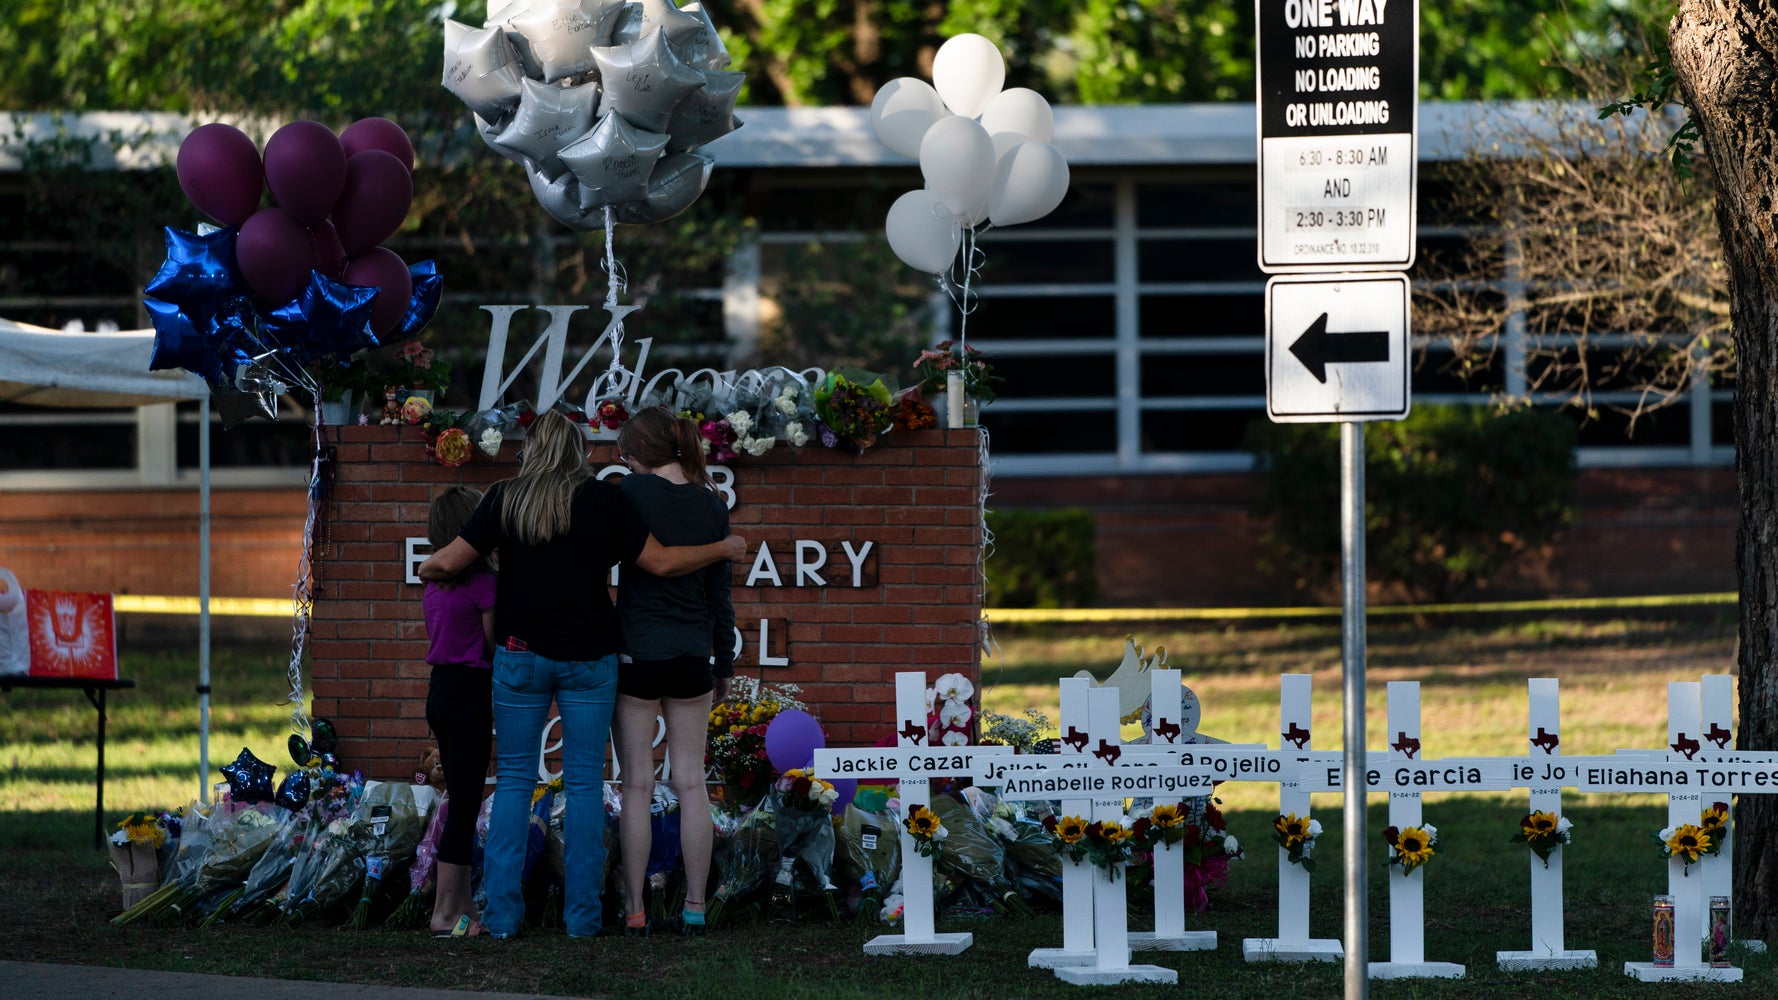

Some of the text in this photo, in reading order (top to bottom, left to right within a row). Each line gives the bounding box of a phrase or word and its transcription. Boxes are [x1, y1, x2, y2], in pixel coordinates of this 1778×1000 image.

[1285, 0, 1387, 28] ONE WAY
[1295, 32, 1380, 58] NO PARKING
[1295, 66, 1380, 92] NO LOADING
[1286, 100, 1389, 127] OR UNLOADING
[1336, 149, 1363, 165] 8:30
[1368, 146, 1388, 165] AM
[1323, 178, 1351, 198] AND
[1296, 211, 1324, 227] 2:30
[1336, 211, 1364, 227] 3:30
[1367, 208, 1386, 228] PM
[831, 756, 897, 773] Jackie
[908, 755, 973, 772] Cazar
[1541, 763, 1565, 780] Jo
[1005, 774, 1213, 794] Annabelle Rodriguez
[1394, 765, 1482, 786] Garcia
[1587, 768, 1688, 786] Eliahana
[1696, 769, 1778, 786] Torres
